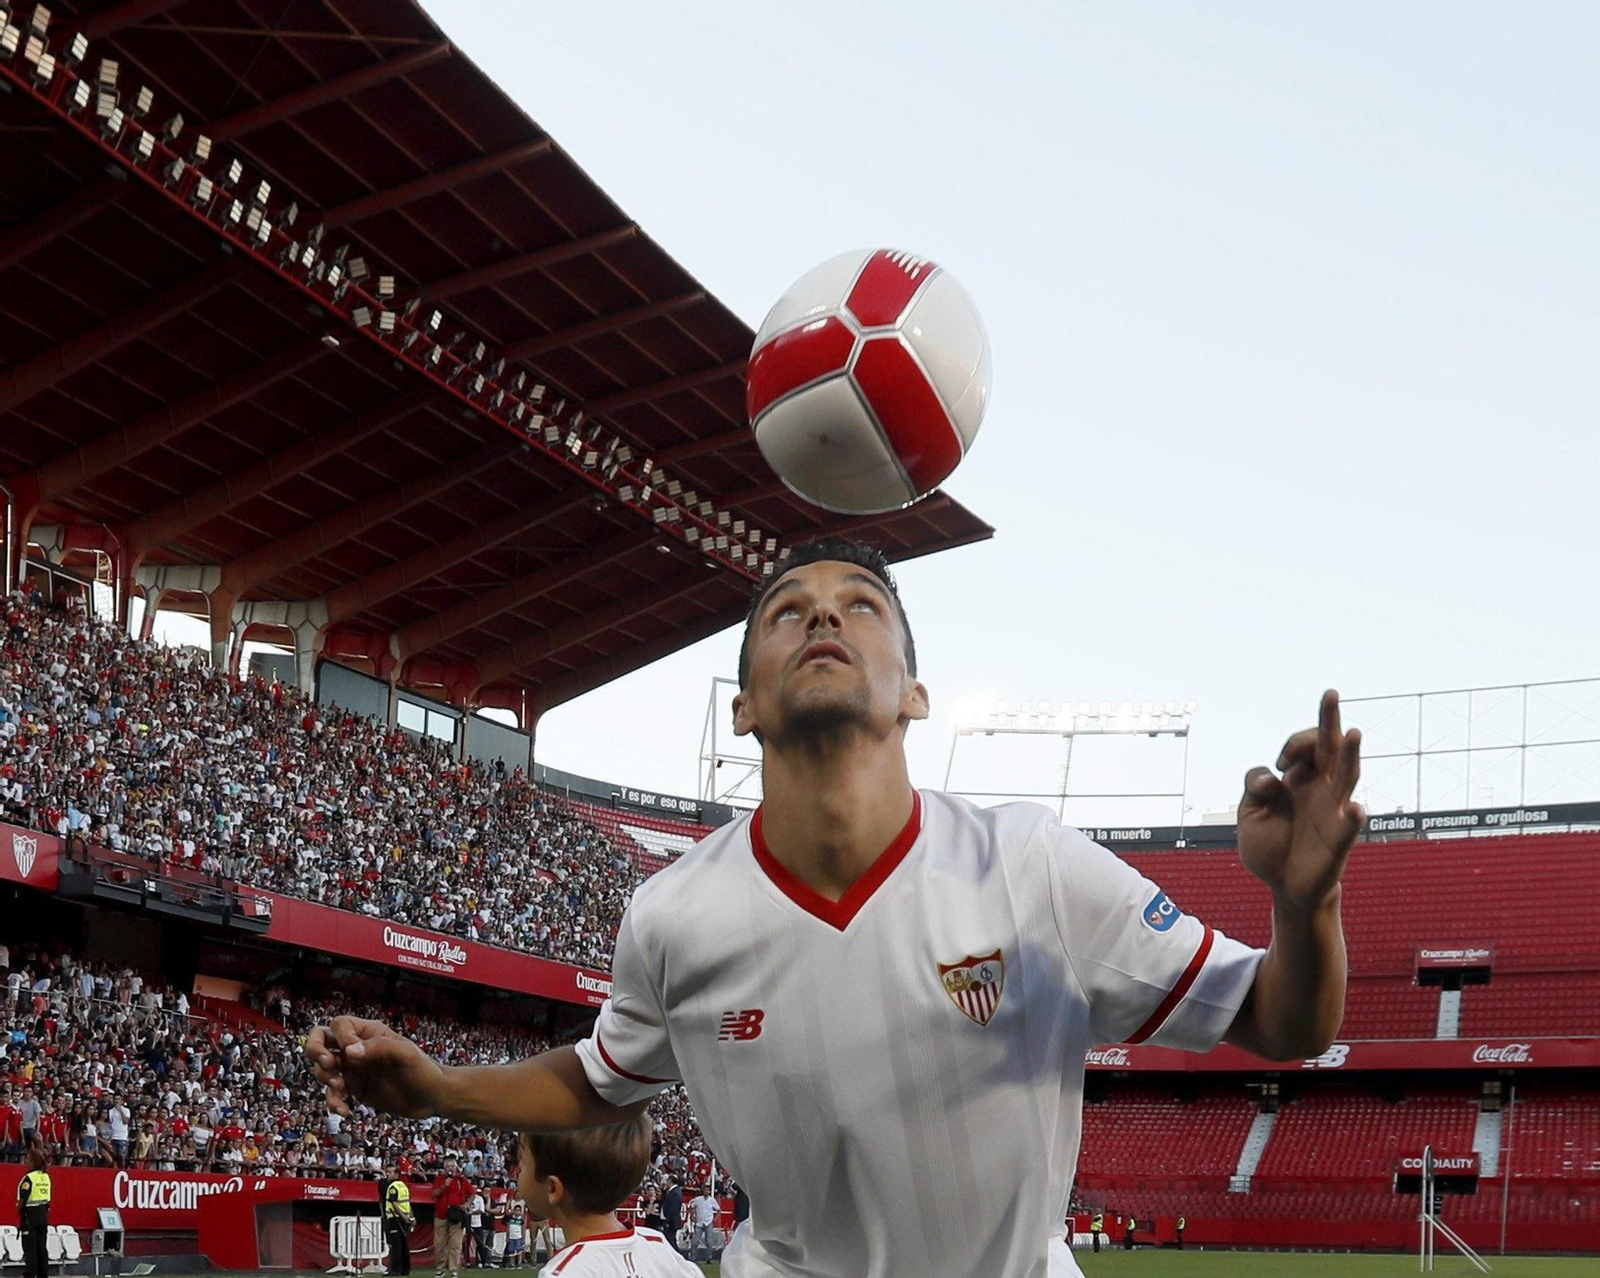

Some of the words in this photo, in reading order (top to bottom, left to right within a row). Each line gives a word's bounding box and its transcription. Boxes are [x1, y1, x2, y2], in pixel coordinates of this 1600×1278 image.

[621, 787, 627, 799] Y
[628, 790, 640, 802] es
[641, 793, 656, 805] por
[660, 797, 677, 809] eso
[679, 801, 697, 812] que
[1369, 816, 1415, 832] Giralda
[1421, 814, 1479, 830] presume
[1485, 810, 1549, 826] orgullosa
[1097, 829, 1108, 840] la
[1110, 828, 1152, 840] muerte
[383, 926, 438, 958] Cruzcampo
[438, 940, 467, 965] Radler
[576, 971, 613, 998] Cruzcamp
[1402, 1158, 1474, 1169] CODIALITY
